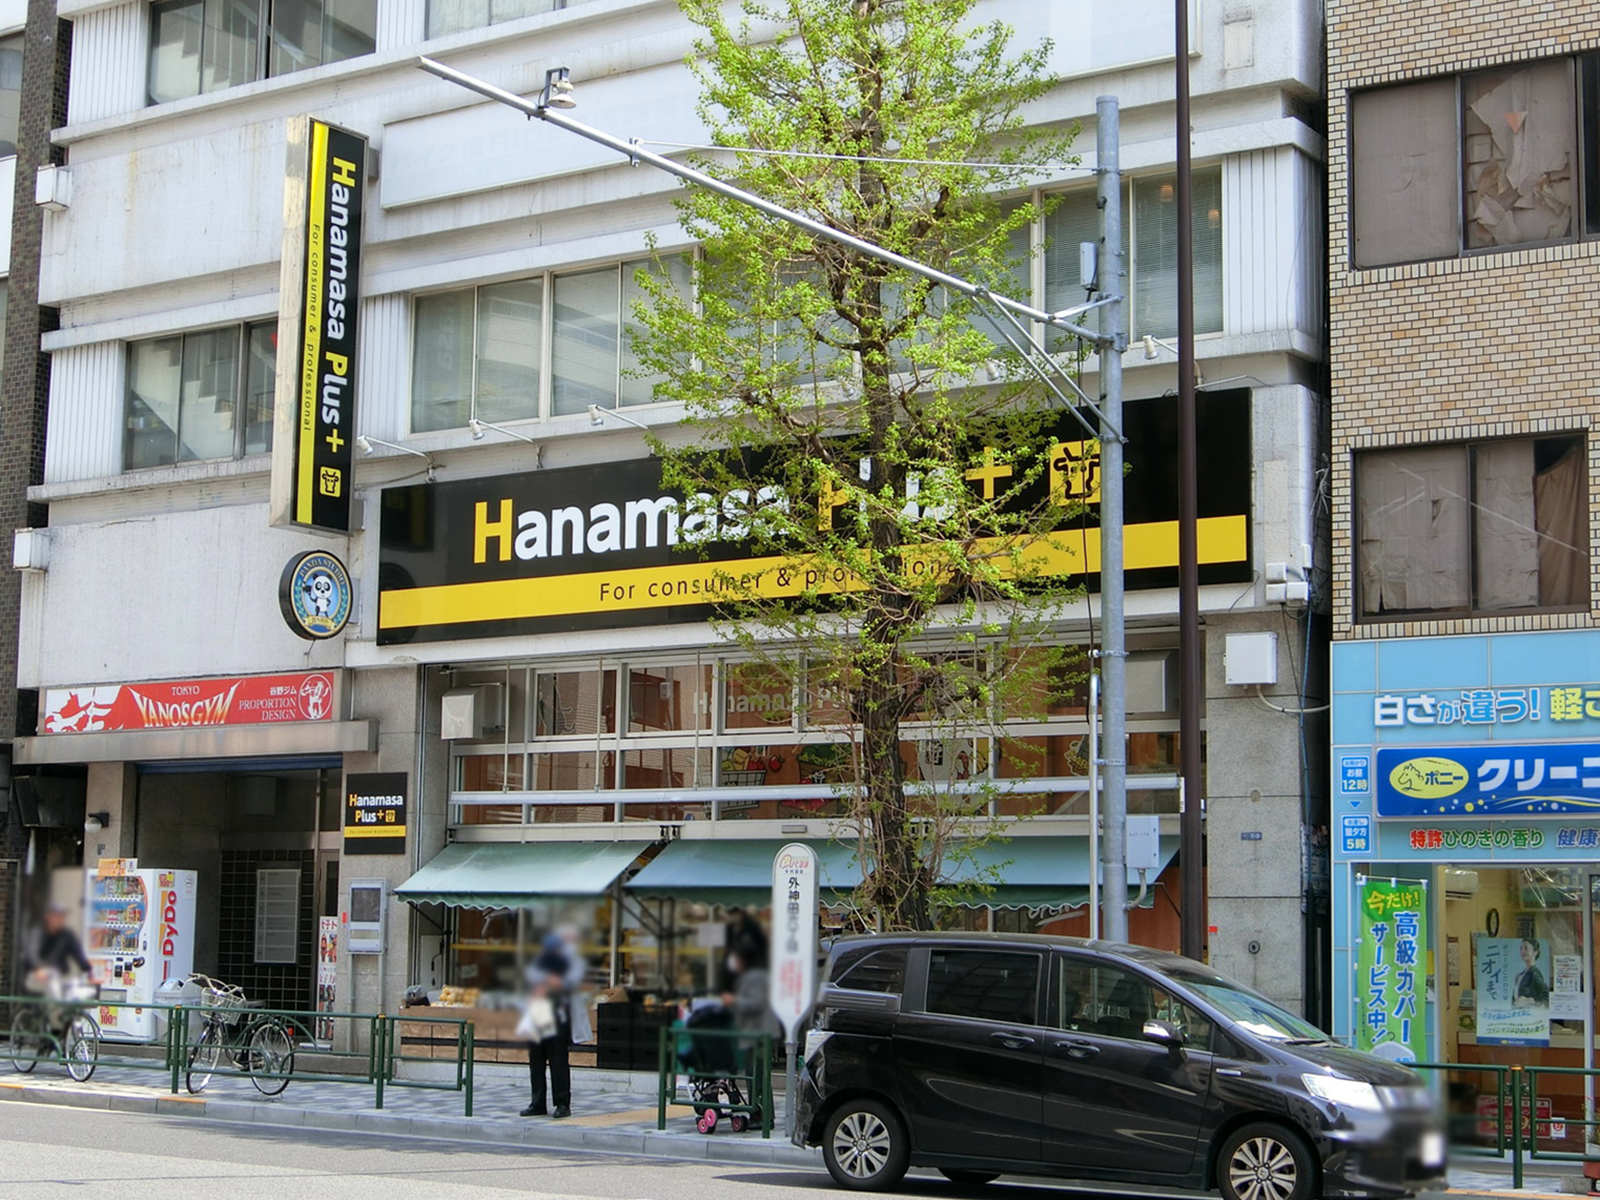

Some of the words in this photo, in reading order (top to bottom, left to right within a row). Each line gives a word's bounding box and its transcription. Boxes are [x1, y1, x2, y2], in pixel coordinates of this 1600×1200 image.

[311, 224, 321, 246] For
[327, 156, 356, 340] Hanamasa
[309, 253, 320, 319] consumer
[303, 343, 315, 431] professional
[299, 558, 322, 577] PANDA
[323, 560, 346, 585] STUDIO
[599, 582, 636, 602] For
[648, 574, 763, 597] consumer
[776, 567, 791, 588] &
[171, 685, 200, 696] TOKYO
[269, 686, 297, 696] 谷野ジム
[238, 697, 297, 710] PROPORTION
[1374, 688, 1541, 727] 白さが違う!
[260, 709, 297, 721] DESIGN
[1343, 779, 1368, 790] 12時
[1424, 770, 1464, 786] ポニー
[349, 793, 404, 807] Hanamasa
[1346, 838, 1366, 849] 5時
[1410, 828, 1545, 850] 特許ひのきの香り
[1366, 890, 1420, 915] 今だけ!
[1367, 922, 1390, 1044] サービス中!
[1392, 911, 1420, 1044] 高級カバー
